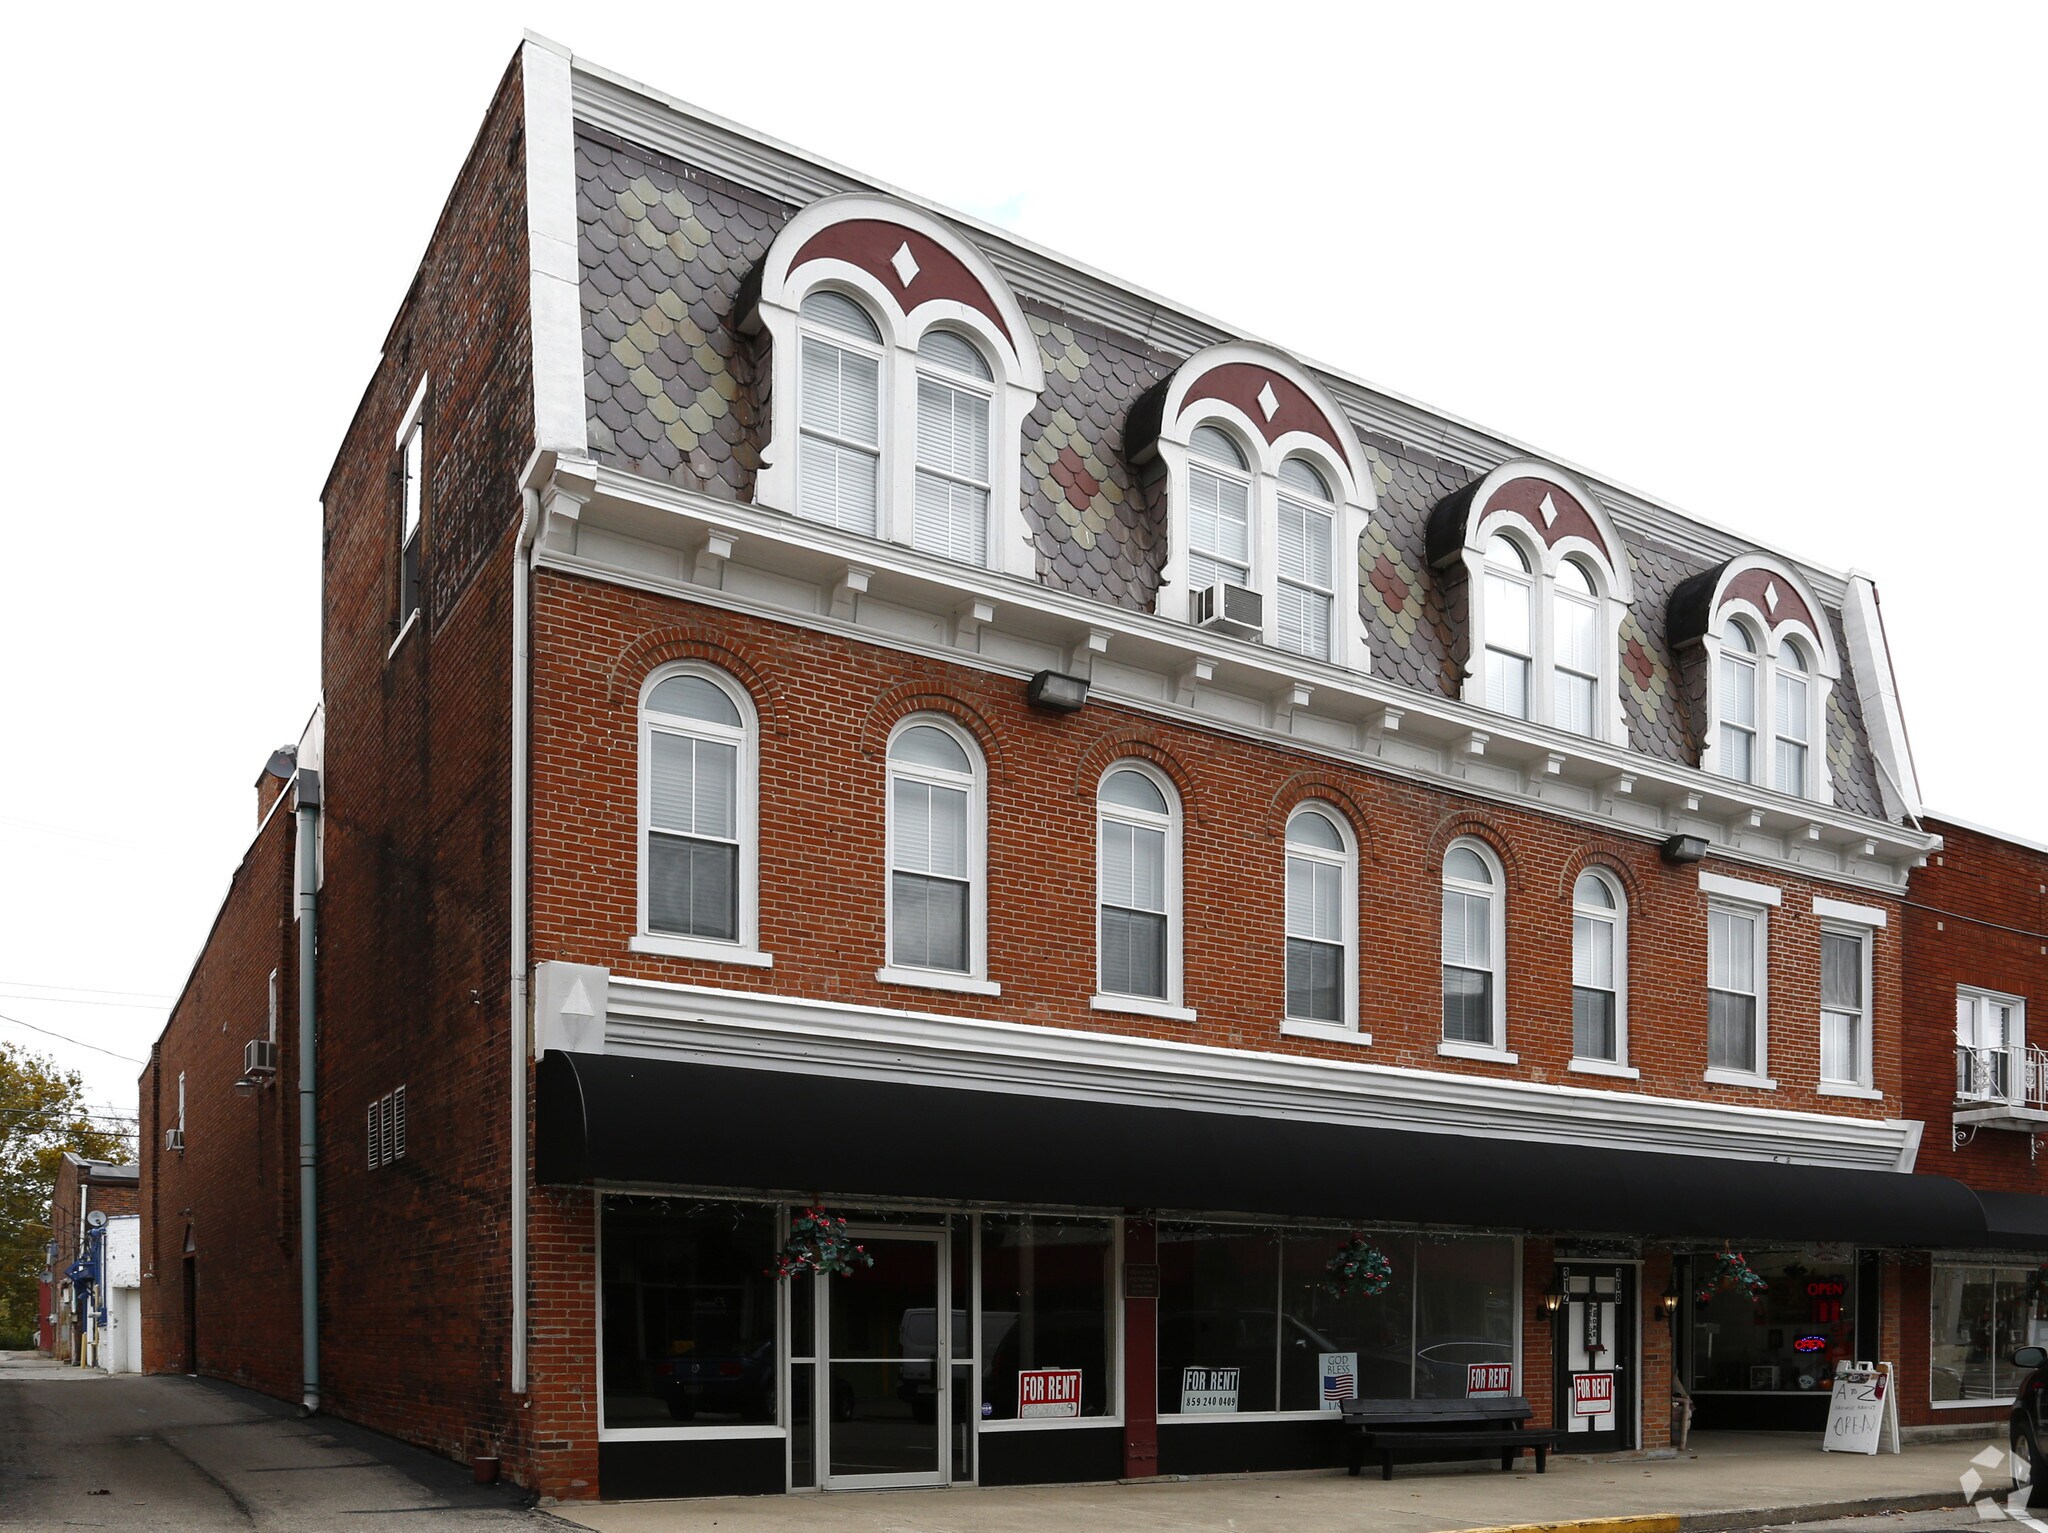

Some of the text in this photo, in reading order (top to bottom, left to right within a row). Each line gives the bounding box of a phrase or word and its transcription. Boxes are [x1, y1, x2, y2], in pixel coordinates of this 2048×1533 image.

[1808, 1283, 1843, 1296] OPEN
[1794, 1340, 1825, 1349] OPEN
[1327, 1365, 1350, 1375] BLESS
[1328, 1356, 1348, 1365] GOD
[1023, 1375, 1077, 1401] FOR RENT
[1186, 1371, 1237, 1391] FOR RENT
[1470, 1368, 1509, 1389] FOR RENT
[1577, 1378, 1610, 1399] FOR RENT
[1835, 1383, 1846, 1400] A
[1857, 1385, 1876, 1402] Z
[1186, 1397, 1235, 1406] 859 240 0409
[1834, 1414, 1876, 1436] OPEN
